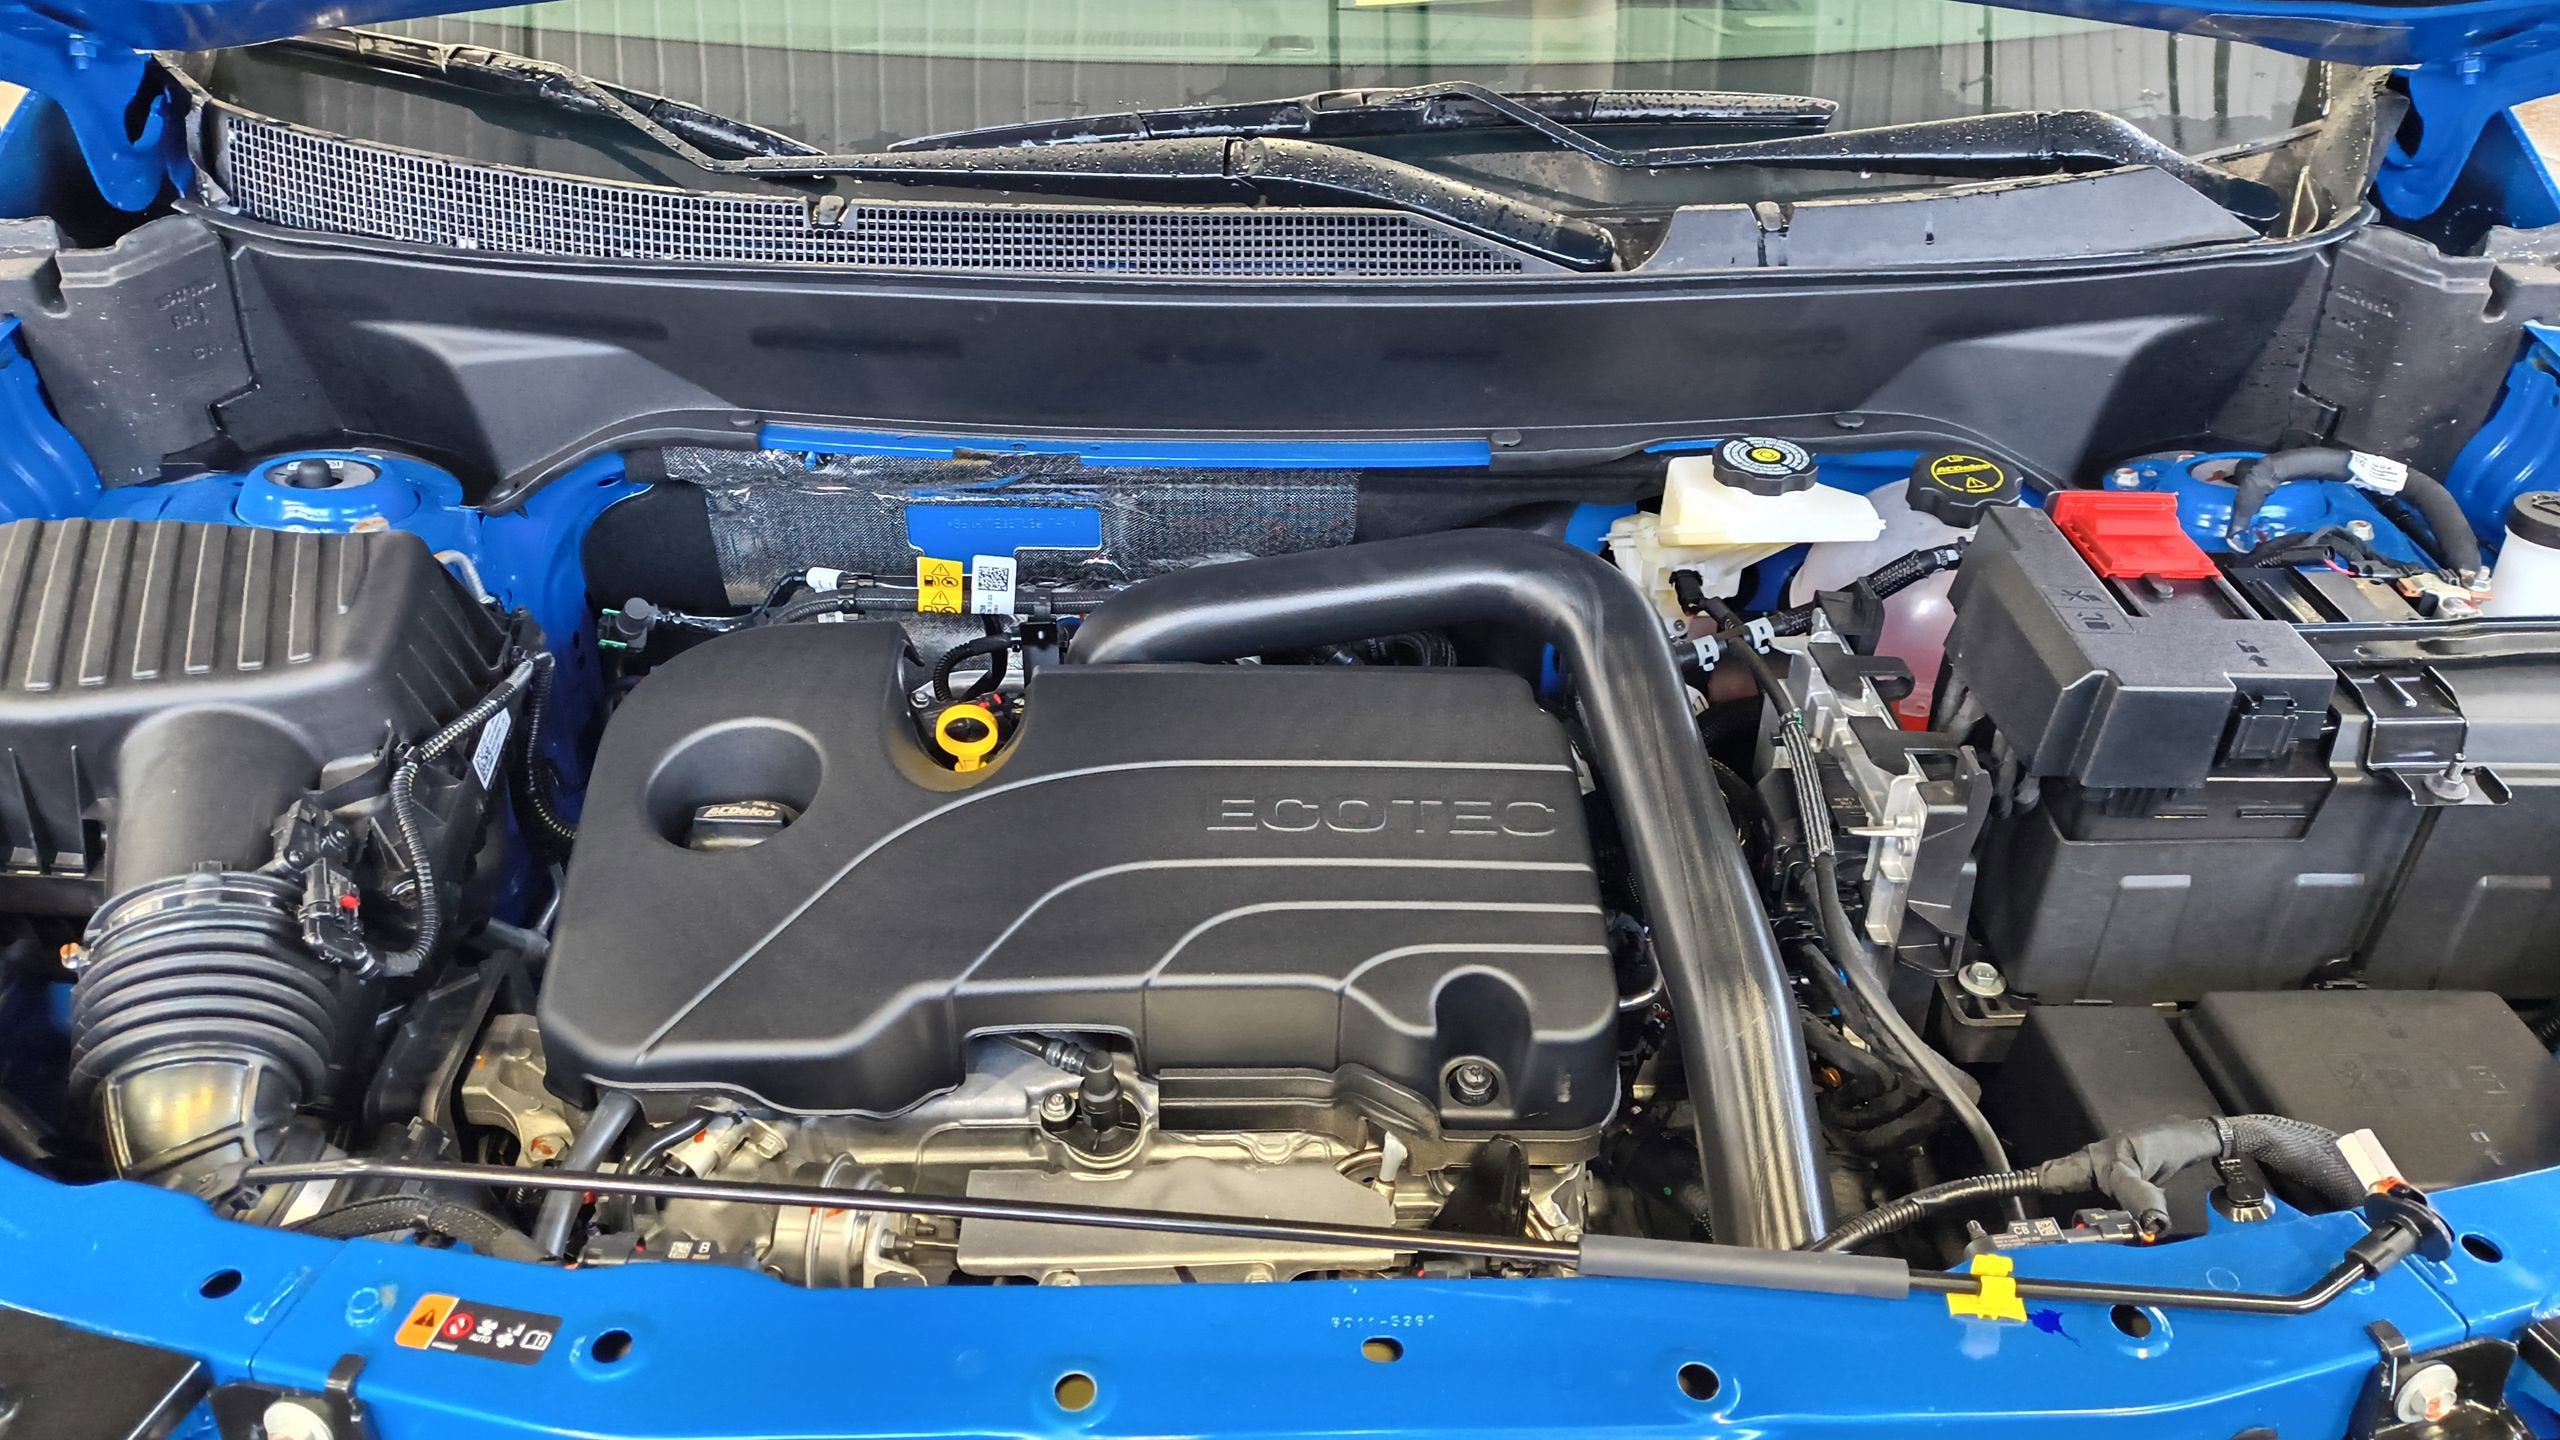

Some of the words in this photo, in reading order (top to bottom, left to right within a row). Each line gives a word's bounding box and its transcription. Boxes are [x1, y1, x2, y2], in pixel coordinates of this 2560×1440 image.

[703, 806, 776, 817] ACDelco
[1206, 798, 1557, 837] ECOTEC
[469, 1333, 492, 1344] AUTO
